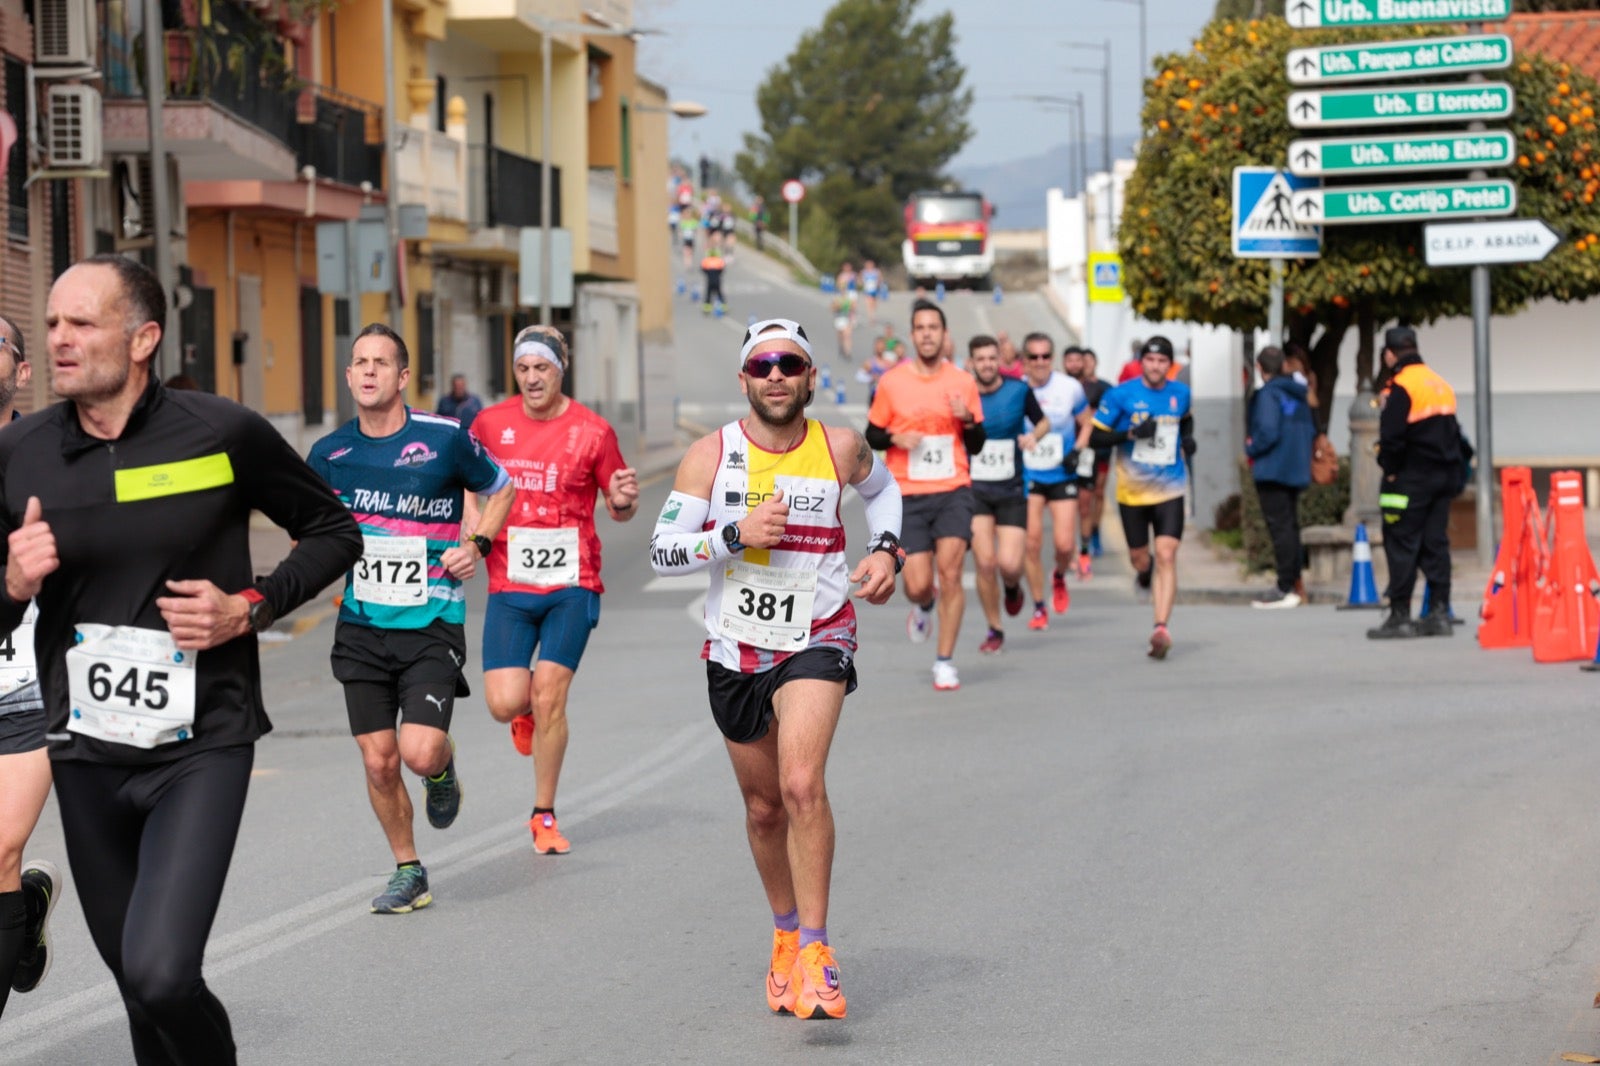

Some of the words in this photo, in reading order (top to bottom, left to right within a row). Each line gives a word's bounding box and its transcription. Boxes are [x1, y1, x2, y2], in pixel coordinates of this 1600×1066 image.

[1324, 0, 1373, 22] Urb.
[1377, 0, 1506, 19] Buenavista
[1322, 53, 1356, 73] Urb.
[1358, 51, 1412, 71] Parque
[1414, 46, 1439, 66] del
[1441, 42, 1502, 63] Cubillas
[1373, 94, 1412, 114] Urb.
[1416, 92, 1434, 112] El
[1438, 90, 1503, 112] torreón
[1351, 145, 1389, 164] Urb.
[1393, 142, 1449, 162] Monte
[1453, 138, 1503, 159] Elvira
[1347, 193, 1386, 213] Urb.
[1389, 190, 1449, 213] Cortijo
[1452, 187, 1506, 208] Pretel
[923, 449, 942, 464] 43
[980, 453, 1005, 466] 451
[353, 488, 394, 512] TRAIL
[396, 494, 453, 520] WALKERS
[358, 557, 421, 584] 3172
[522, 548, 567, 569] 322
[738, 588, 795, 623] 381
[88, 662, 169, 711] 645
